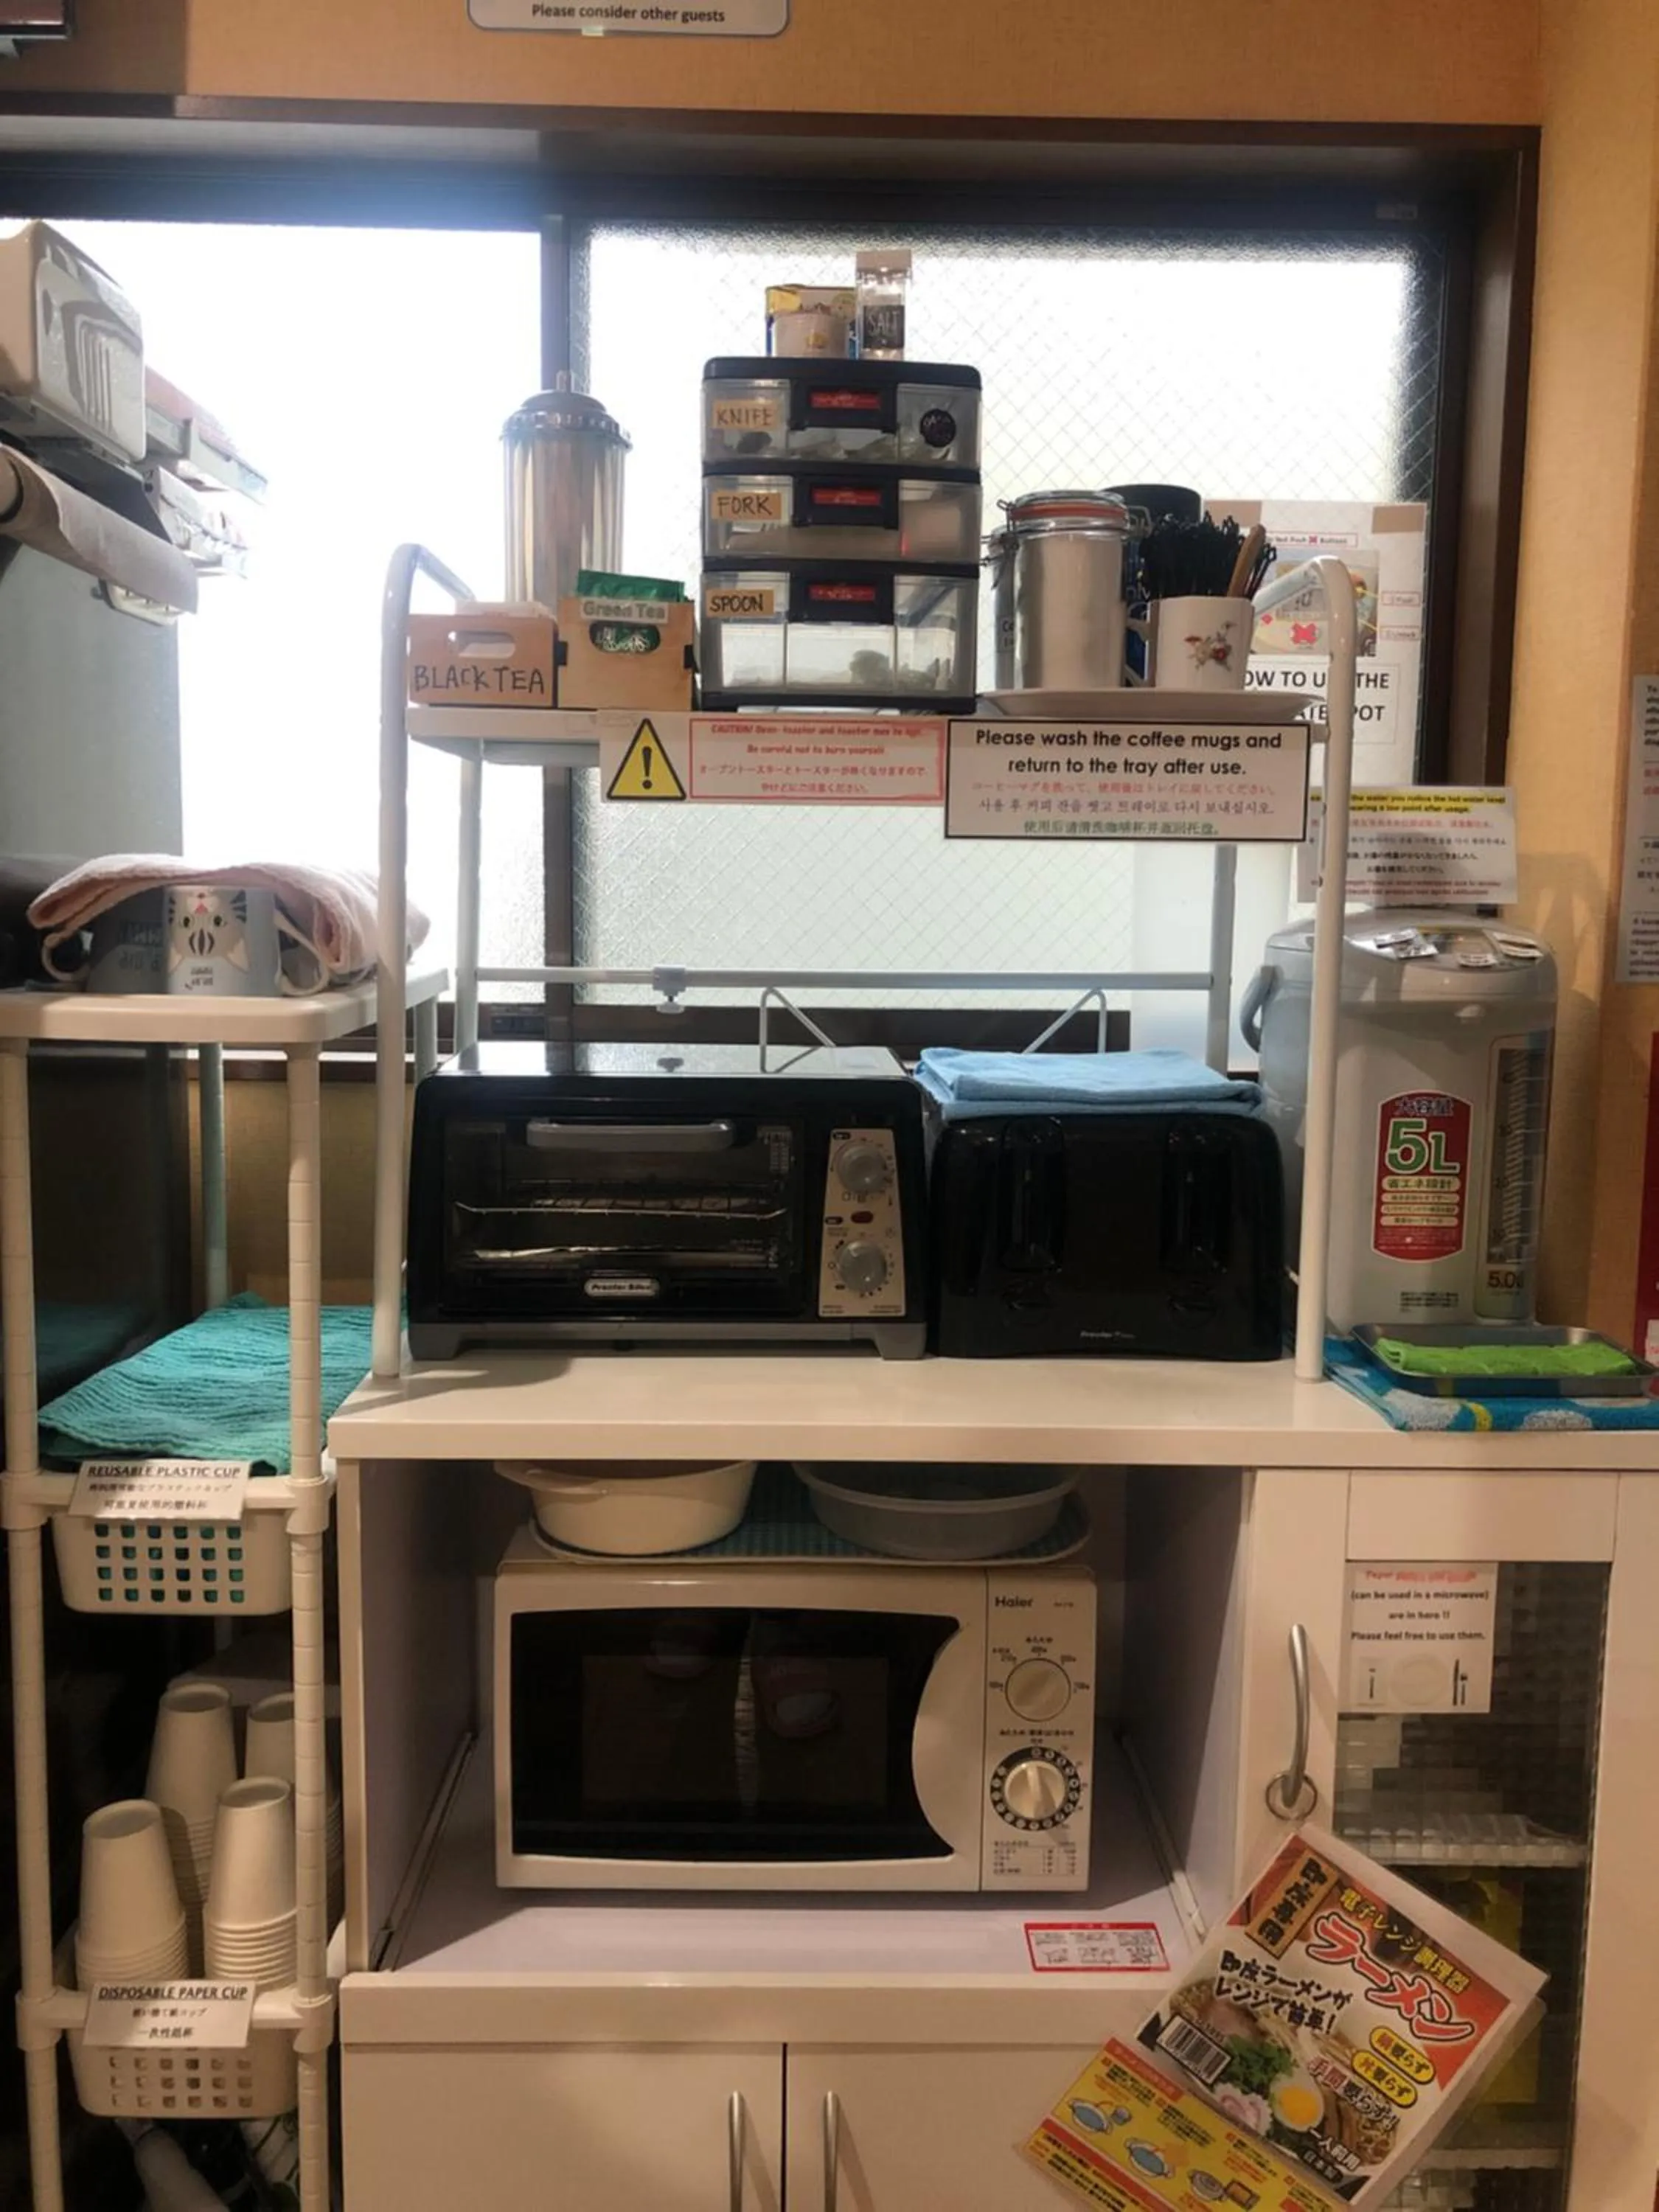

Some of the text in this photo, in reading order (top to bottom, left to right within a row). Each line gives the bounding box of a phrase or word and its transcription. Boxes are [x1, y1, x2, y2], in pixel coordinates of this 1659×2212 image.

[532, 4, 725, 24] Please consider other guests
[715, 407, 773, 429] KNIFE
[717, 495, 773, 516] FORK
[583, 601, 666, 620] Green Tea
[709, 594, 764, 612] SPOON
[414, 664, 545, 695] BLACK TEA
[1281, 671, 1307, 688] TO
[975, 728, 1282, 751] Please wash the coffee mugs and
[1008, 757, 1247, 776] return to the tray after use.
[1384, 1117, 1461, 1175] 5L
[87, 1466, 241, 1478] REUSABLE PLASTIC CUP
[995, 1596, 1034, 1607] Haier
[1374, 1590, 1385, 1599] be
[1413, 1590, 1423, 1599] in
[1350, 1631, 1382, 1641] Please
[1383, 1631, 1403, 1640] feel
[1404, 1631, 1423, 1641] free
[1426, 1631, 1436, 1641] to
[1438, 1632, 1455, 1641] use
[1339, 1888, 1470, 1995] 電子レンジ調理器
[1220, 1949, 1354, 2011] 即席ラーメンが
[1304, 1910, 1476, 2042] ラーメン
[98, 1986, 248, 2001] DISPOSABLE PAPER CUP
[1308, 2126, 1361, 2172] 一人前用
